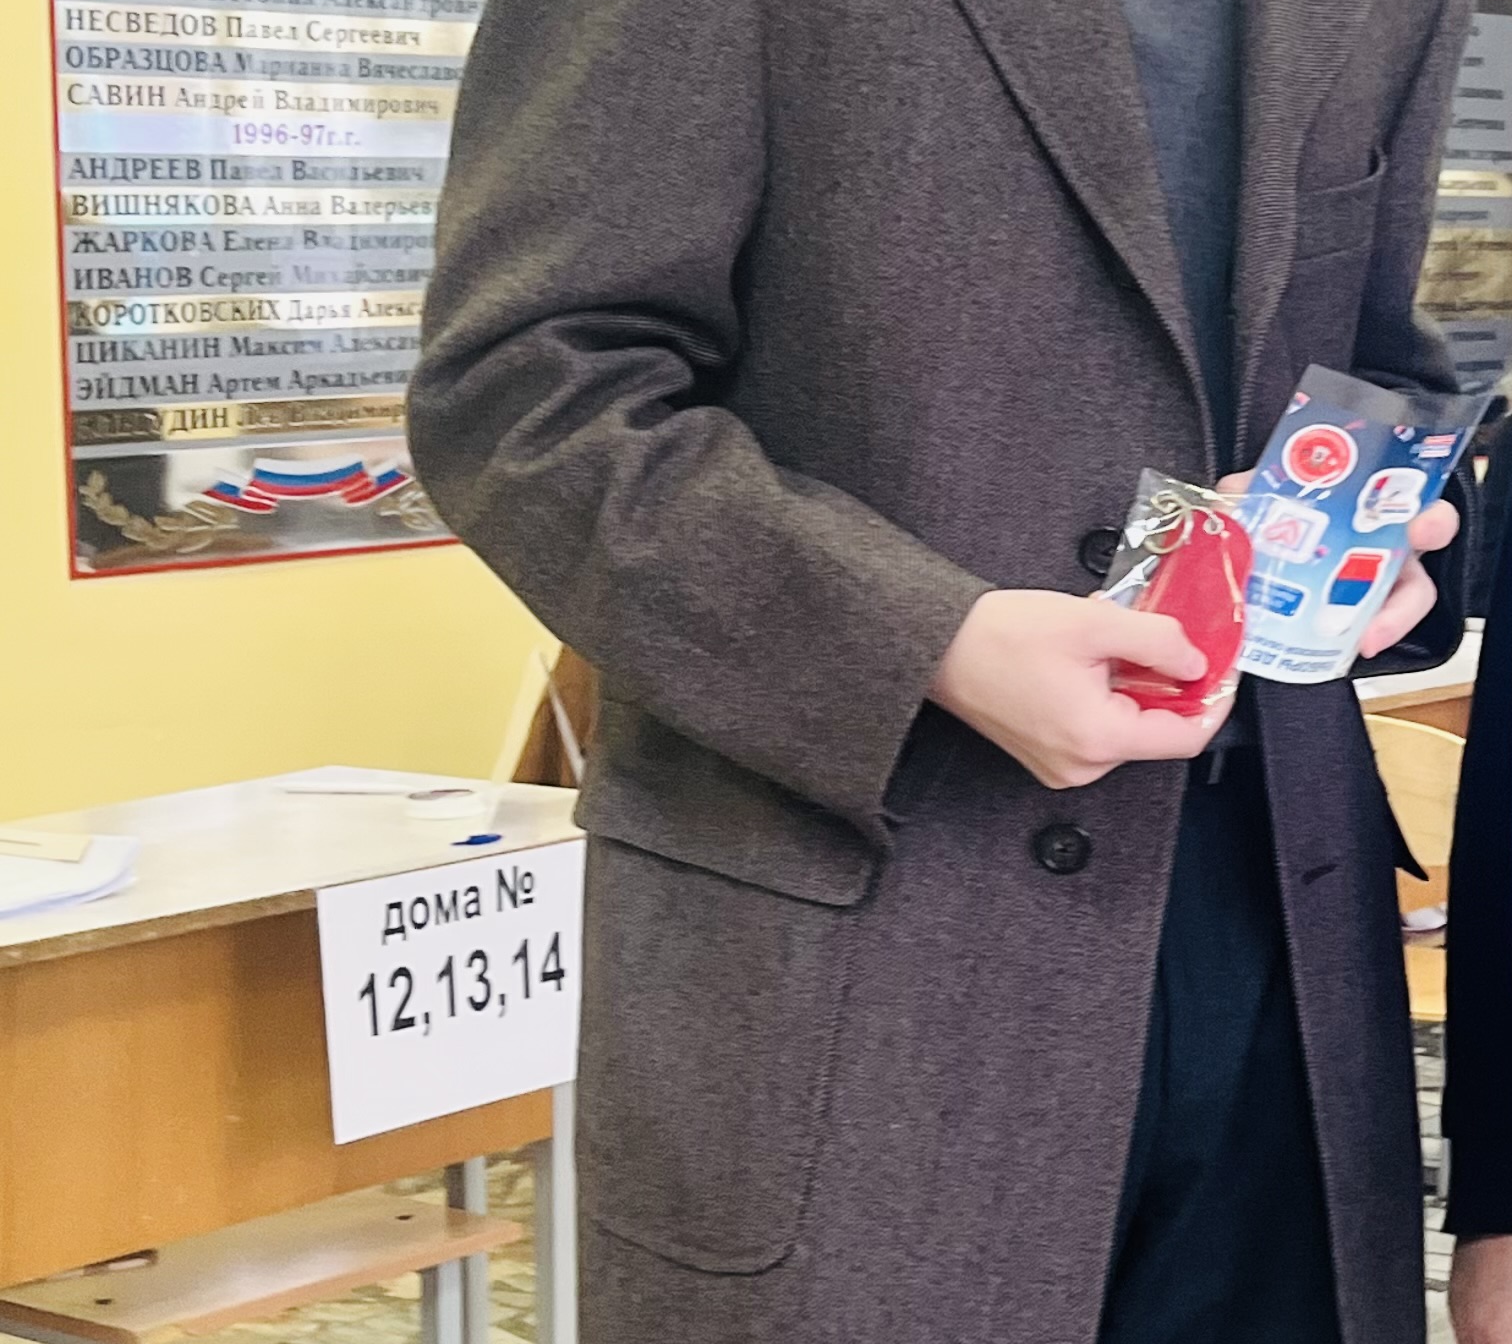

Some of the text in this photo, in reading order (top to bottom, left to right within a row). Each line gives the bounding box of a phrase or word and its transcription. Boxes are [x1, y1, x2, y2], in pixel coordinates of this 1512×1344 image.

[65, 8, 422, 49] НЕСВЕДОВ Павел Сергеевич
[65, 45, 227, 74] ОБРАЗЦОВА
[358, 57, 464, 81] Вячеславо
[67, 82, 440, 120] САВИН Андрей Владимирович
[69, 157, 203, 184] АНДРЕЕВ
[210, 158, 284, 181] Павел
[71, 194, 433, 222] ВИШНЯКОВА Анна Валерьев
[72, 229, 435, 255] ЖАРКОВА Елена Владимиро
[73, 265, 194, 291] ИВАНОВ
[200, 264, 282, 294] Сергей
[74, 298, 281, 328] КОРОТКОВСКИХ
[286, 298, 352, 326] Дарья
[76, 336, 222, 365] ЦИКАНИН
[228, 335, 323, 358] Максим
[77, 369, 411, 401] ЭЙДМАН Артем Аркадьеви
[381, 864, 536, 945] дома №
[358, 930, 567, 1038] 12,13,14
